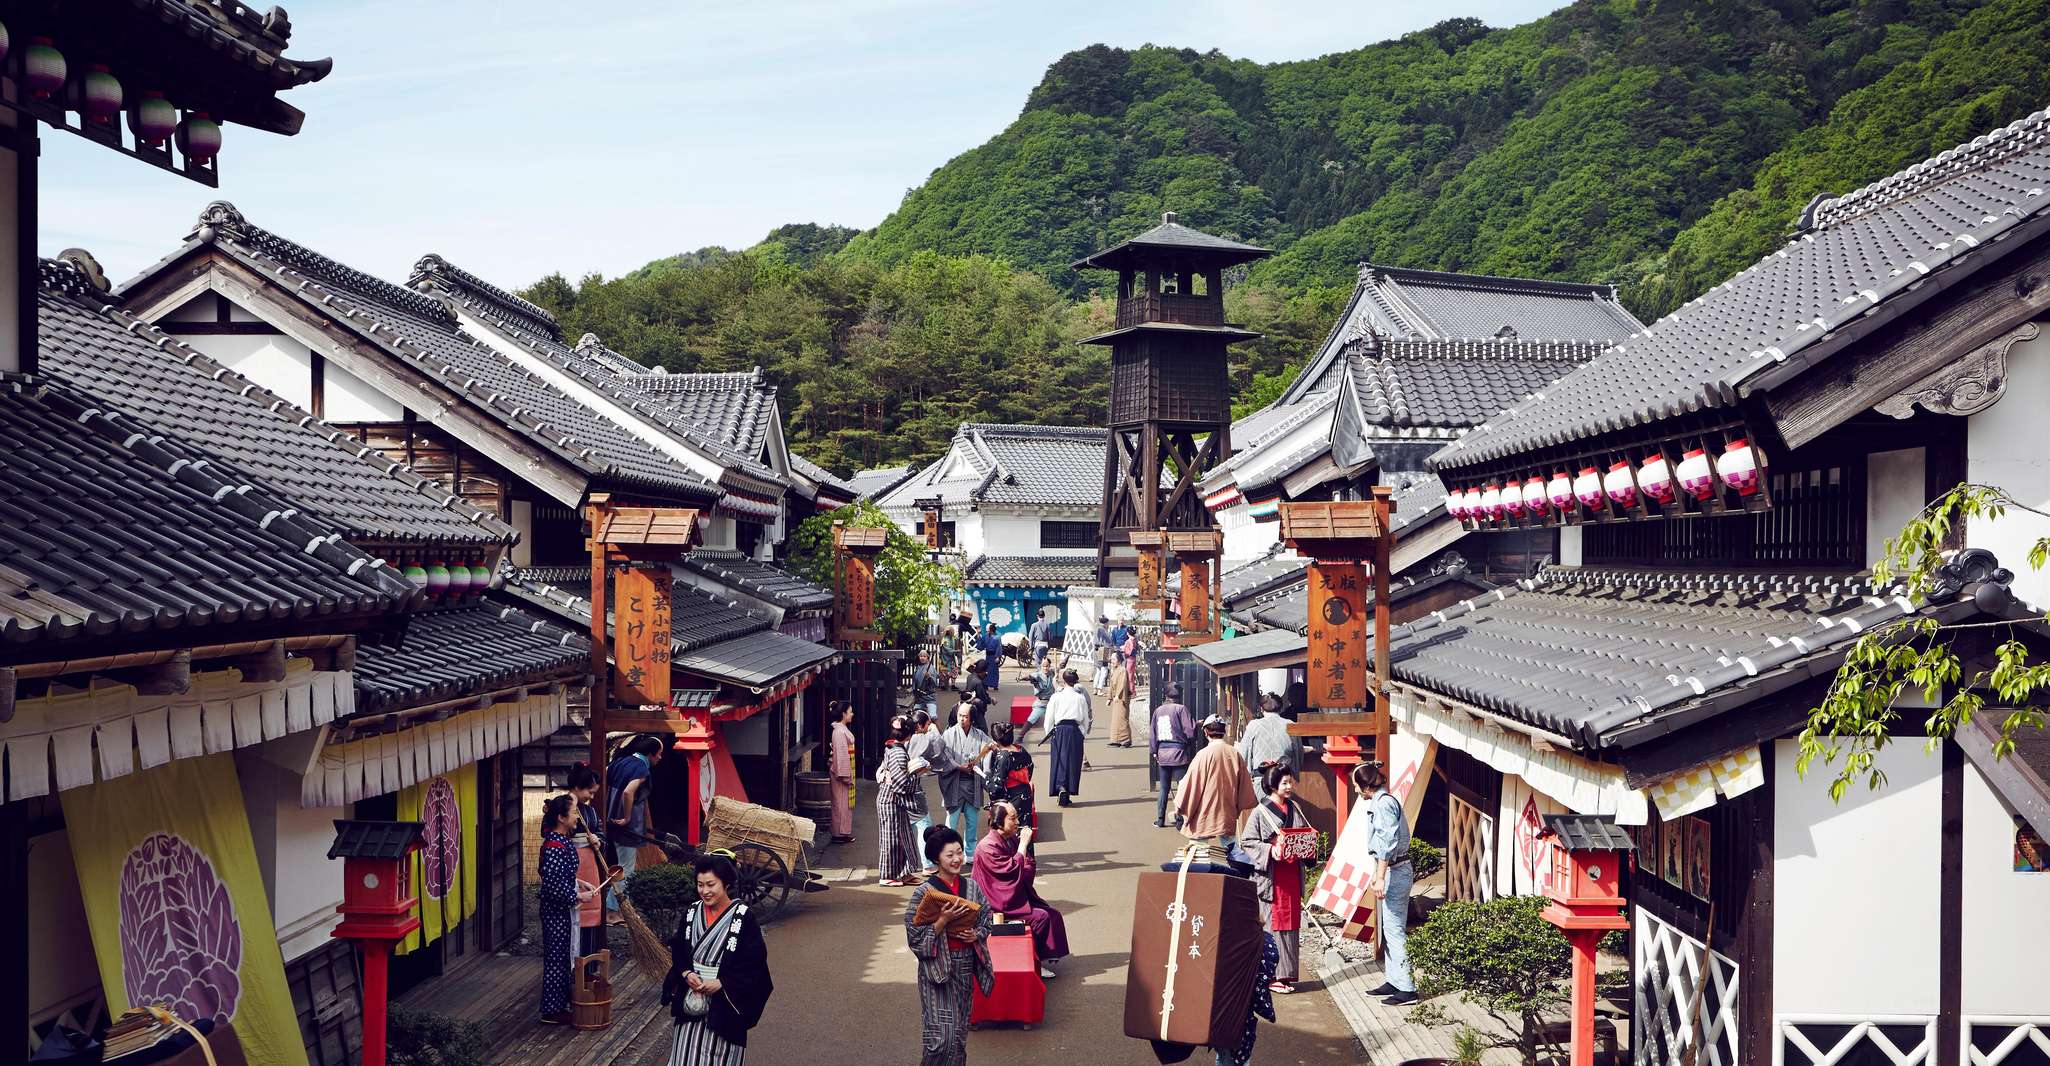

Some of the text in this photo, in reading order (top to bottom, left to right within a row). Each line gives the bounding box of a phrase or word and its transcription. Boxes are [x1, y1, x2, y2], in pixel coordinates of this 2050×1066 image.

[626, 596, 647, 688] こけし堂
[651, 577, 670, 664] 民芸小間物
[1187, 914, 1204, 960] 貸本
